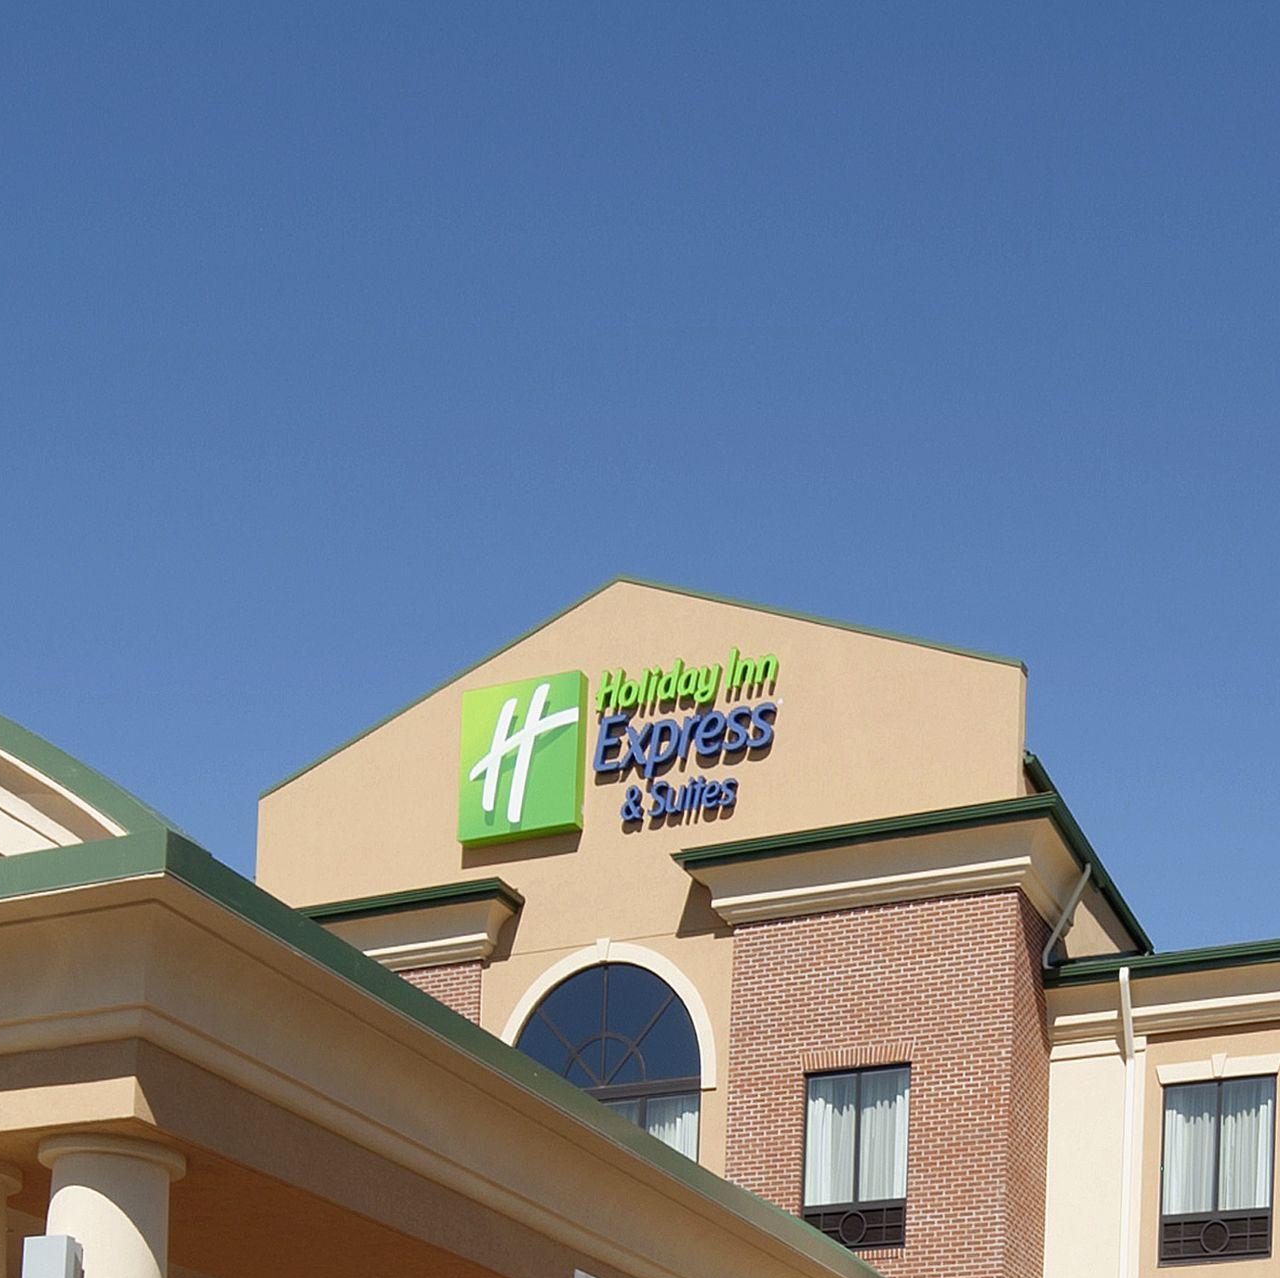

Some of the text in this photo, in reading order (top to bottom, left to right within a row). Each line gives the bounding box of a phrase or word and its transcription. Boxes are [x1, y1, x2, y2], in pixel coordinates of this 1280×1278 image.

[595, 646, 780, 713] Holiday Inn
[593, 701, 777, 779] Express
[621, 775, 739, 821] & Suites
